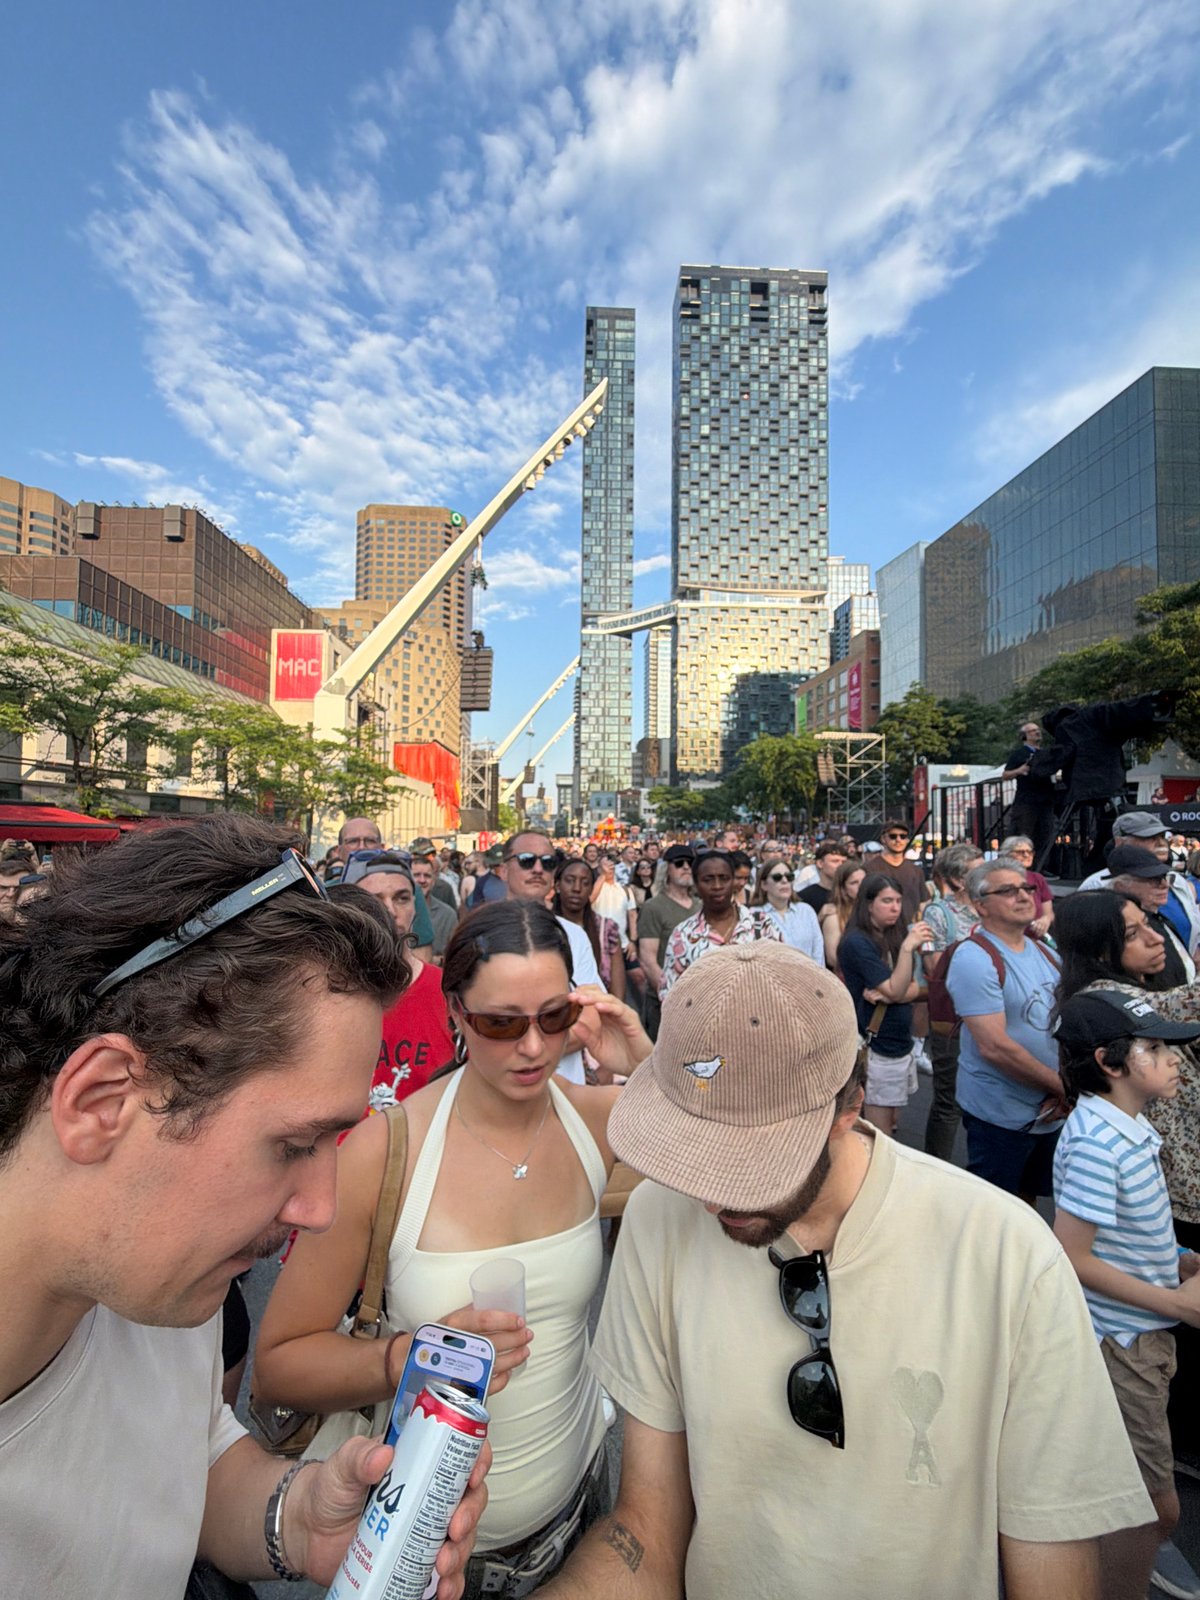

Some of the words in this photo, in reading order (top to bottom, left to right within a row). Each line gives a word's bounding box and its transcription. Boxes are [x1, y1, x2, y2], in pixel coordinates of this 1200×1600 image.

[278, 658, 320, 677] MAC
[376, 1039, 430, 1068] ACE
[355, 1550, 373, 1574] CERISE
